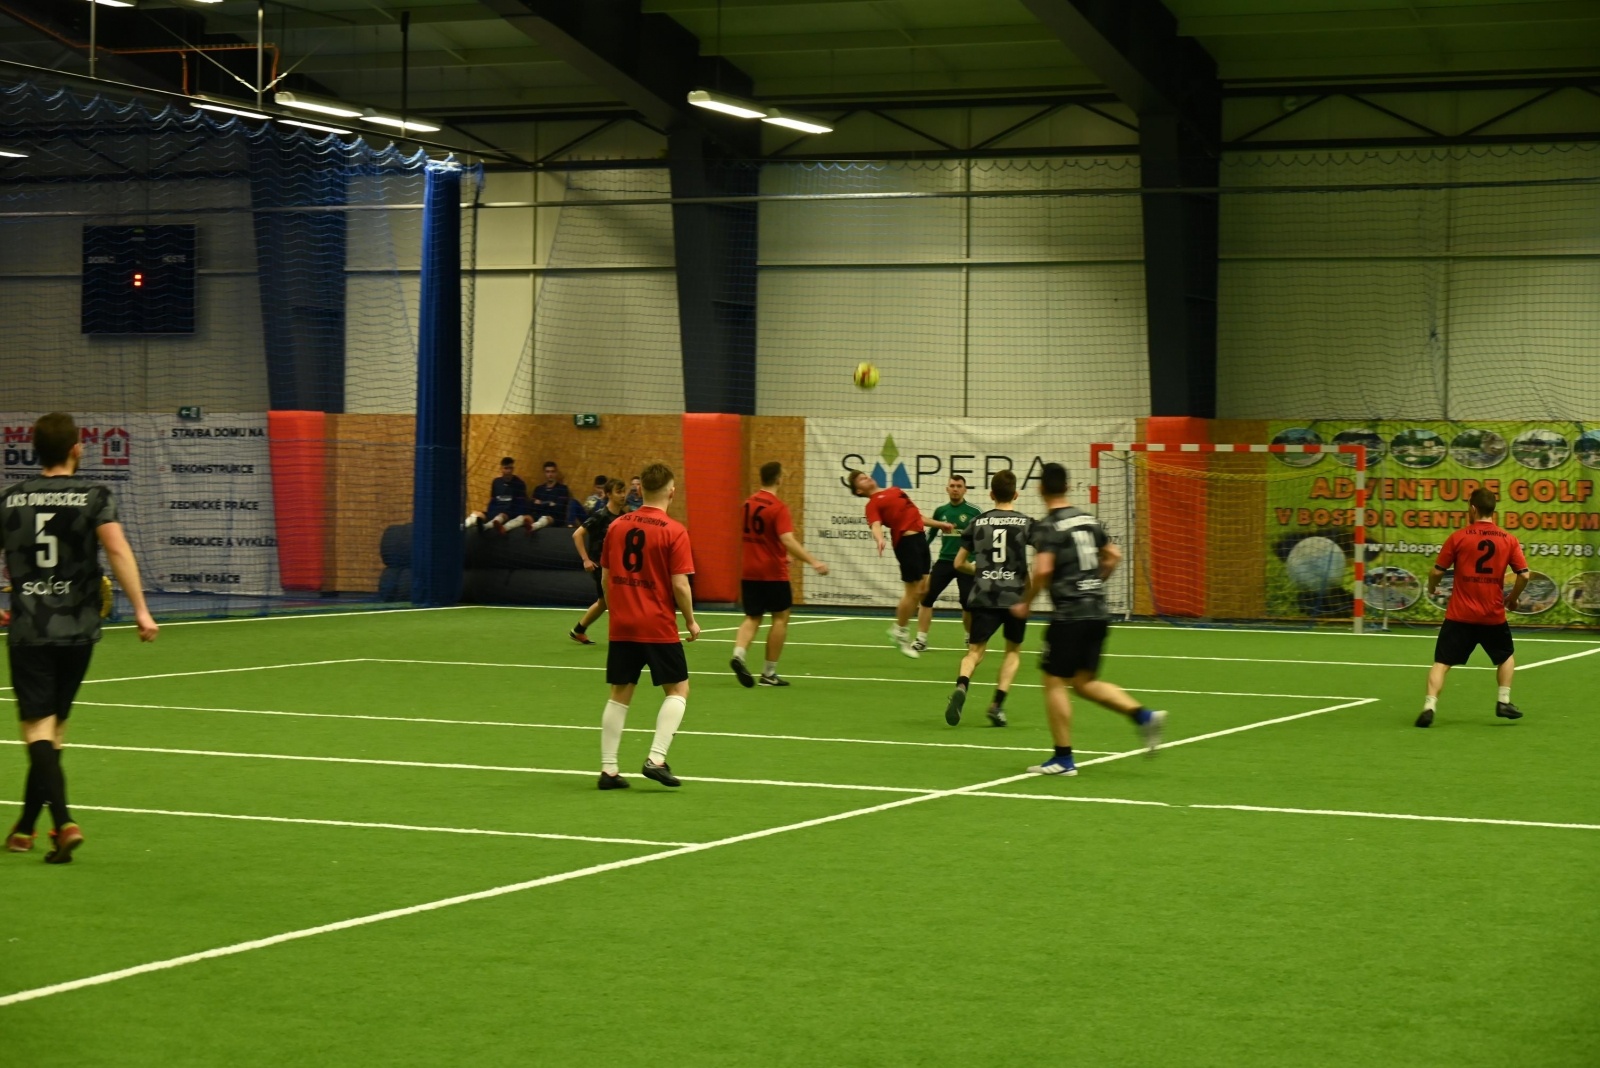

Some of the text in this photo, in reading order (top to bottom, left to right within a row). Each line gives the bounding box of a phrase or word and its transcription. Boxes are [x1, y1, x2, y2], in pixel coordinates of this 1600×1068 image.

[171, 428, 211, 437] STAVBA
[249, 428, 264, 437] NA
[171, 464, 254, 474] REKONSTRUKCE
[1310, 476, 1593, 502] ADVENTURE GOLF
[6, 494, 27, 508] LKS
[224, 499, 259, 510] PRÁCE
[743, 503, 764, 535] 16
[1276, 508, 1293, 525] V
[1296, 508, 1397, 528] BOSPOR
[35, 512, 58, 568] 5
[170, 536, 222, 546] DEMOLICE
[226, 537, 234, 547] A
[992, 528, 1007, 563] 9
[623, 528, 646, 573] 8
[1475, 539, 1495, 574] 2
[1529, 543, 1560, 556] 734
[170, 571, 241, 583] ZEMNÍ PRÁCE
[982, 567, 1017, 581] safer
[22, 575, 73, 595] safer
